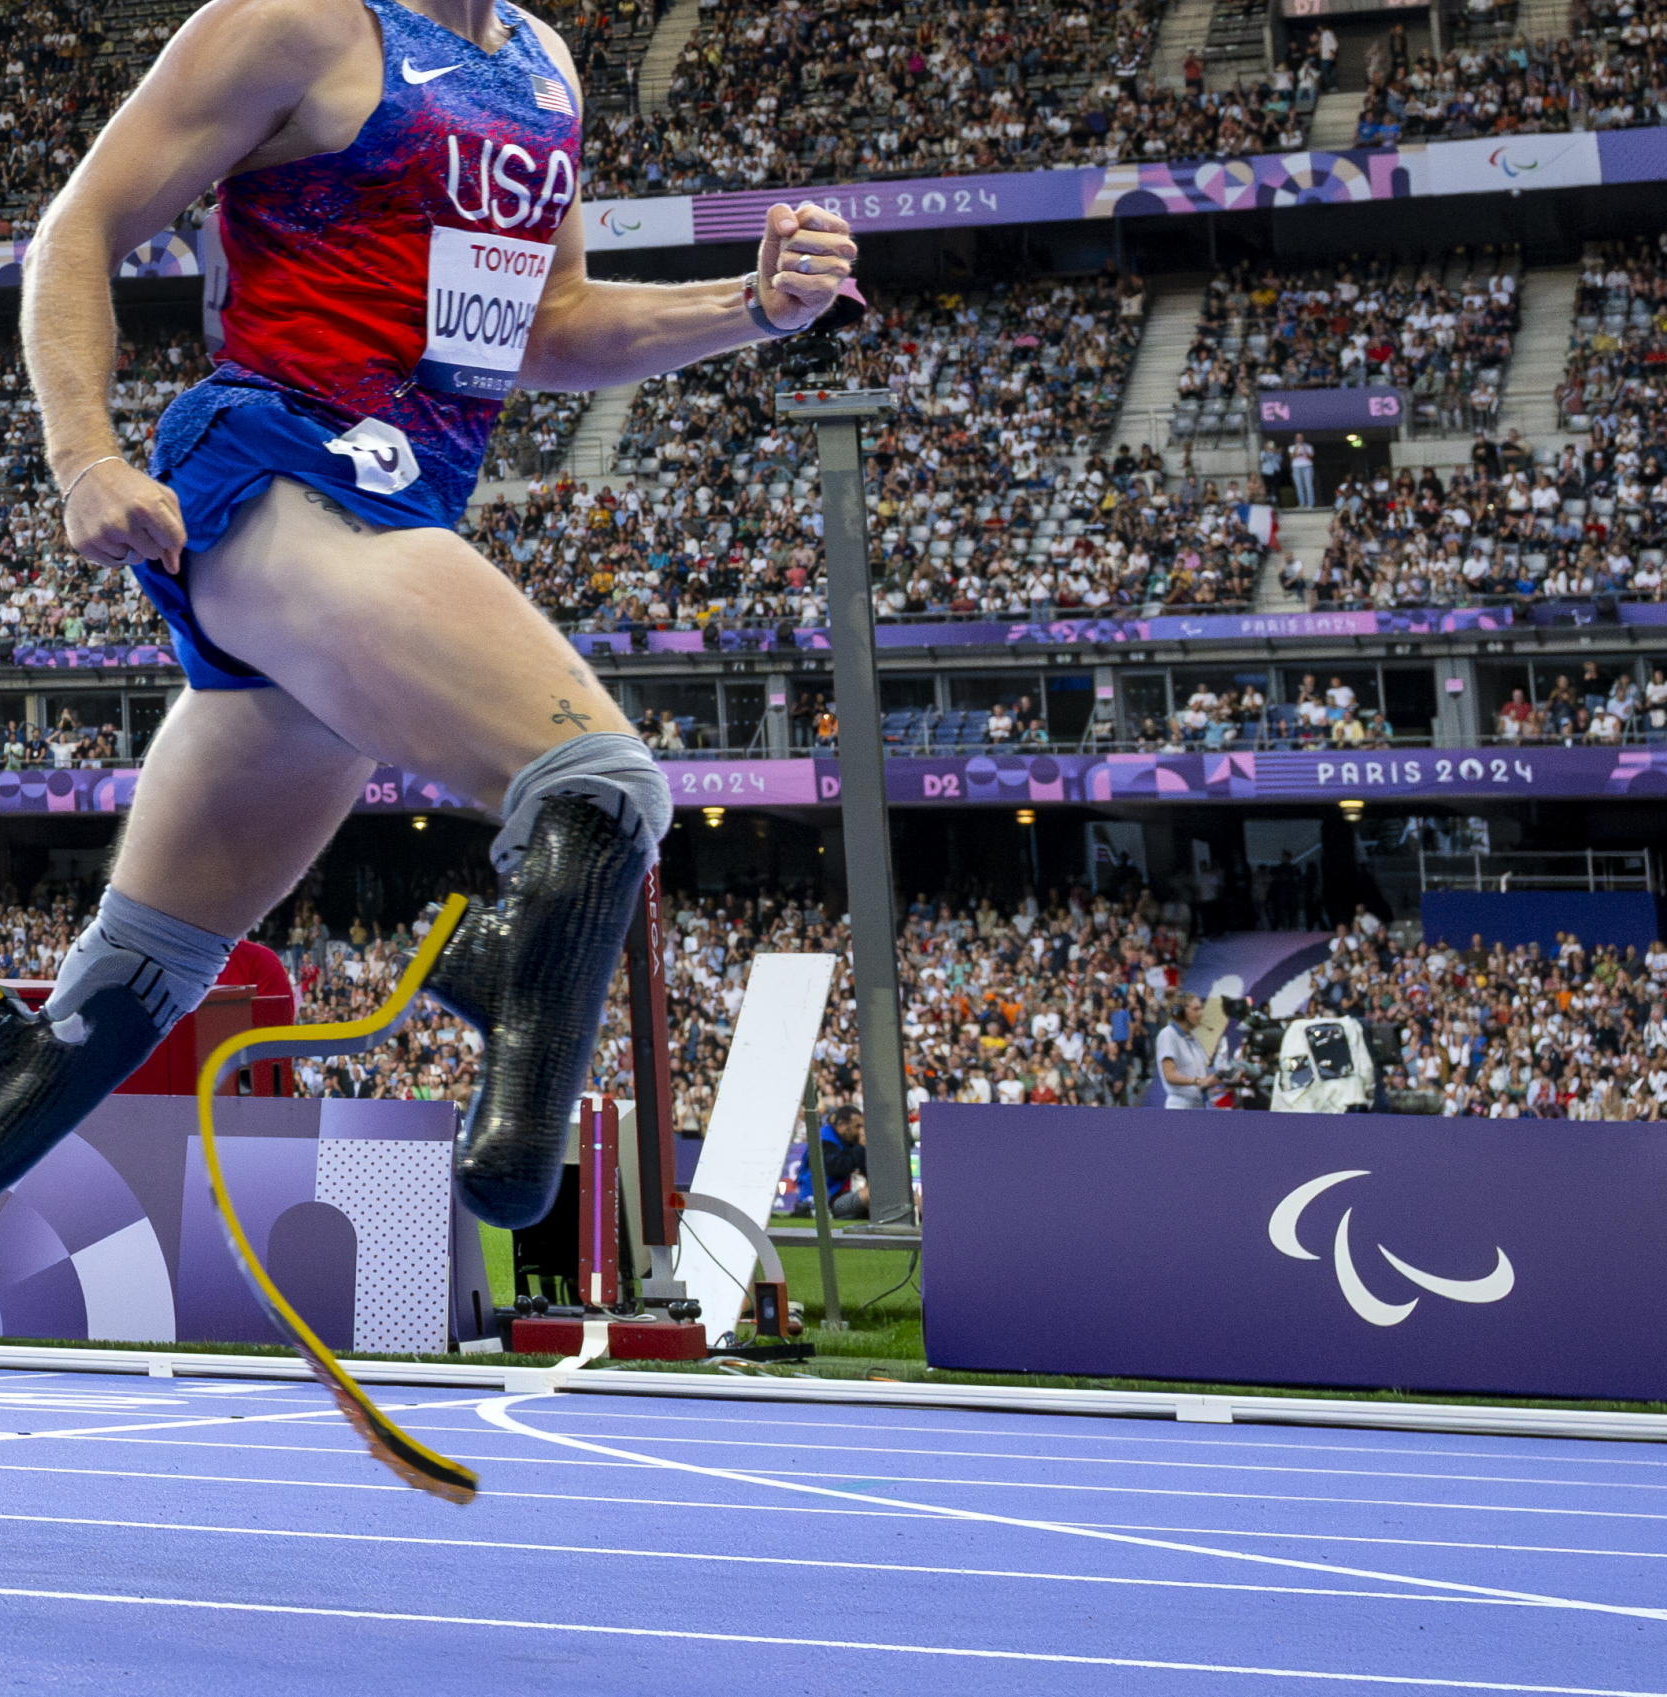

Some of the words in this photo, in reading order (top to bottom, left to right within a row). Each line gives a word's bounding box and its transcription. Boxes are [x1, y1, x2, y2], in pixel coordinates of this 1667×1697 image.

[447, 134, 574, 230] USA
[896, 188, 999, 217] 2024
[470, 244, 546, 277] TOYOTA
[682, 772, 766, 794] 2024
[1318, 761, 1422, 784] PARIS
[1435, 758, 1533, 783] 2024
[365, 782, 398, 804] D5
[924, 775, 960, 798] D2
[648, 870, 661, 978] MEGA
